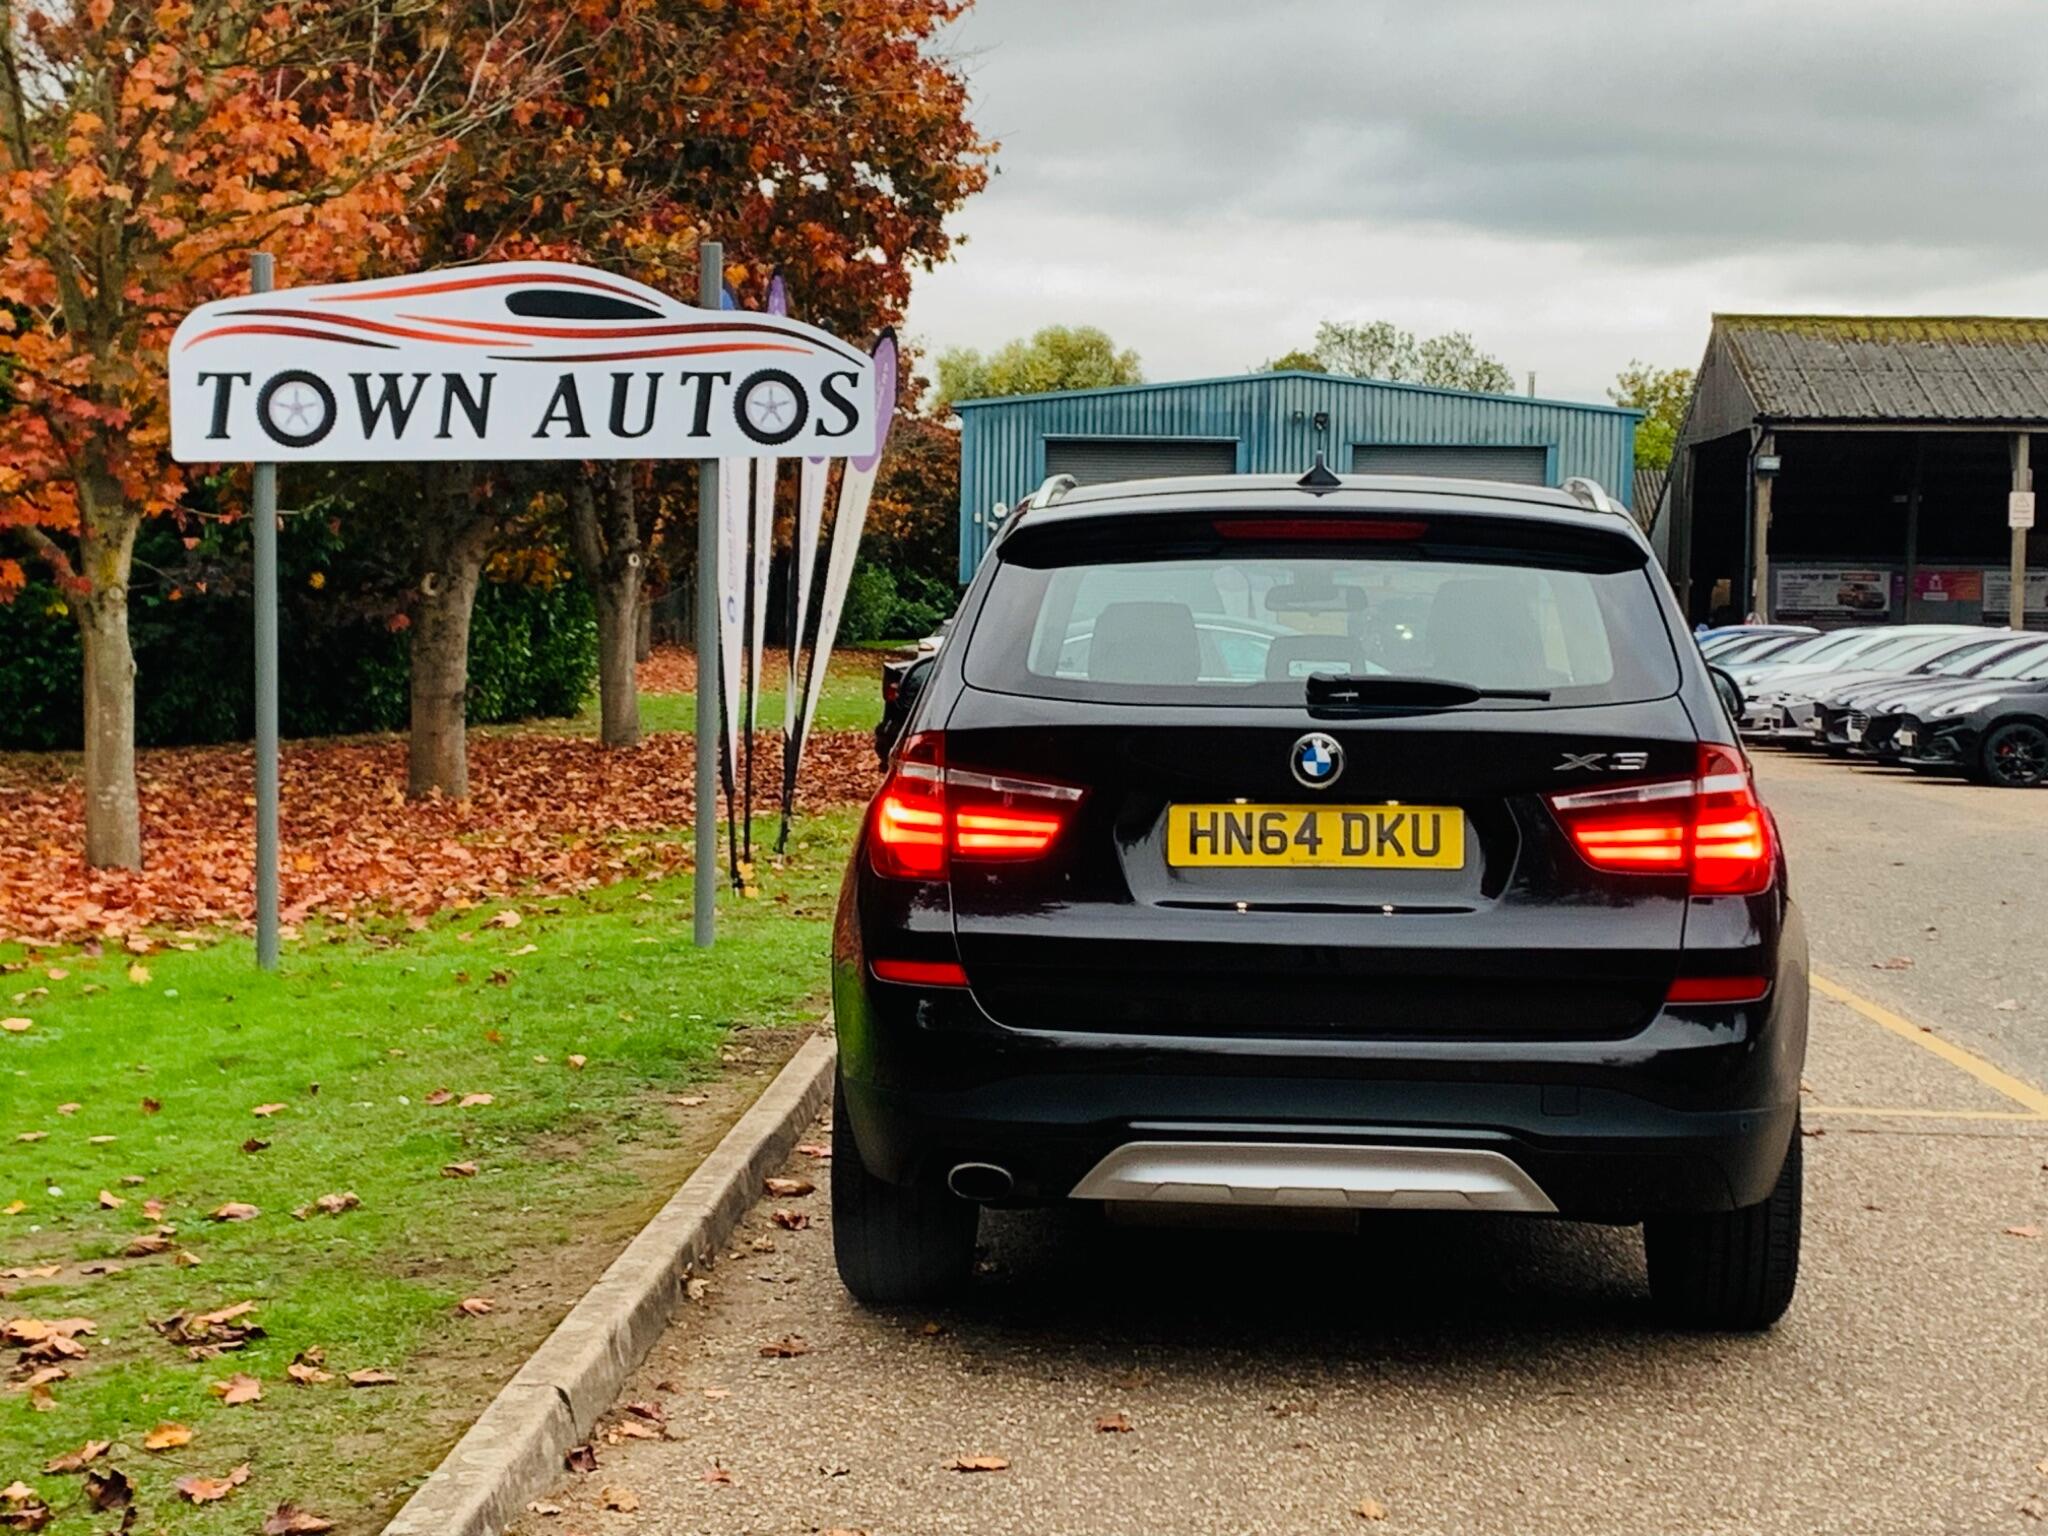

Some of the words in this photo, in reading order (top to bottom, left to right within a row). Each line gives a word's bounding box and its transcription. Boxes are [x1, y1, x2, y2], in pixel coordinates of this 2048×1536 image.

[198, 367, 498, 448] TOWN
[532, 366, 861, 446] AUTOS
[1553, 751, 1648, 771] X3
[1189, 811, 1323, 856] HN64
[1341, 812, 1441, 857] DKU
